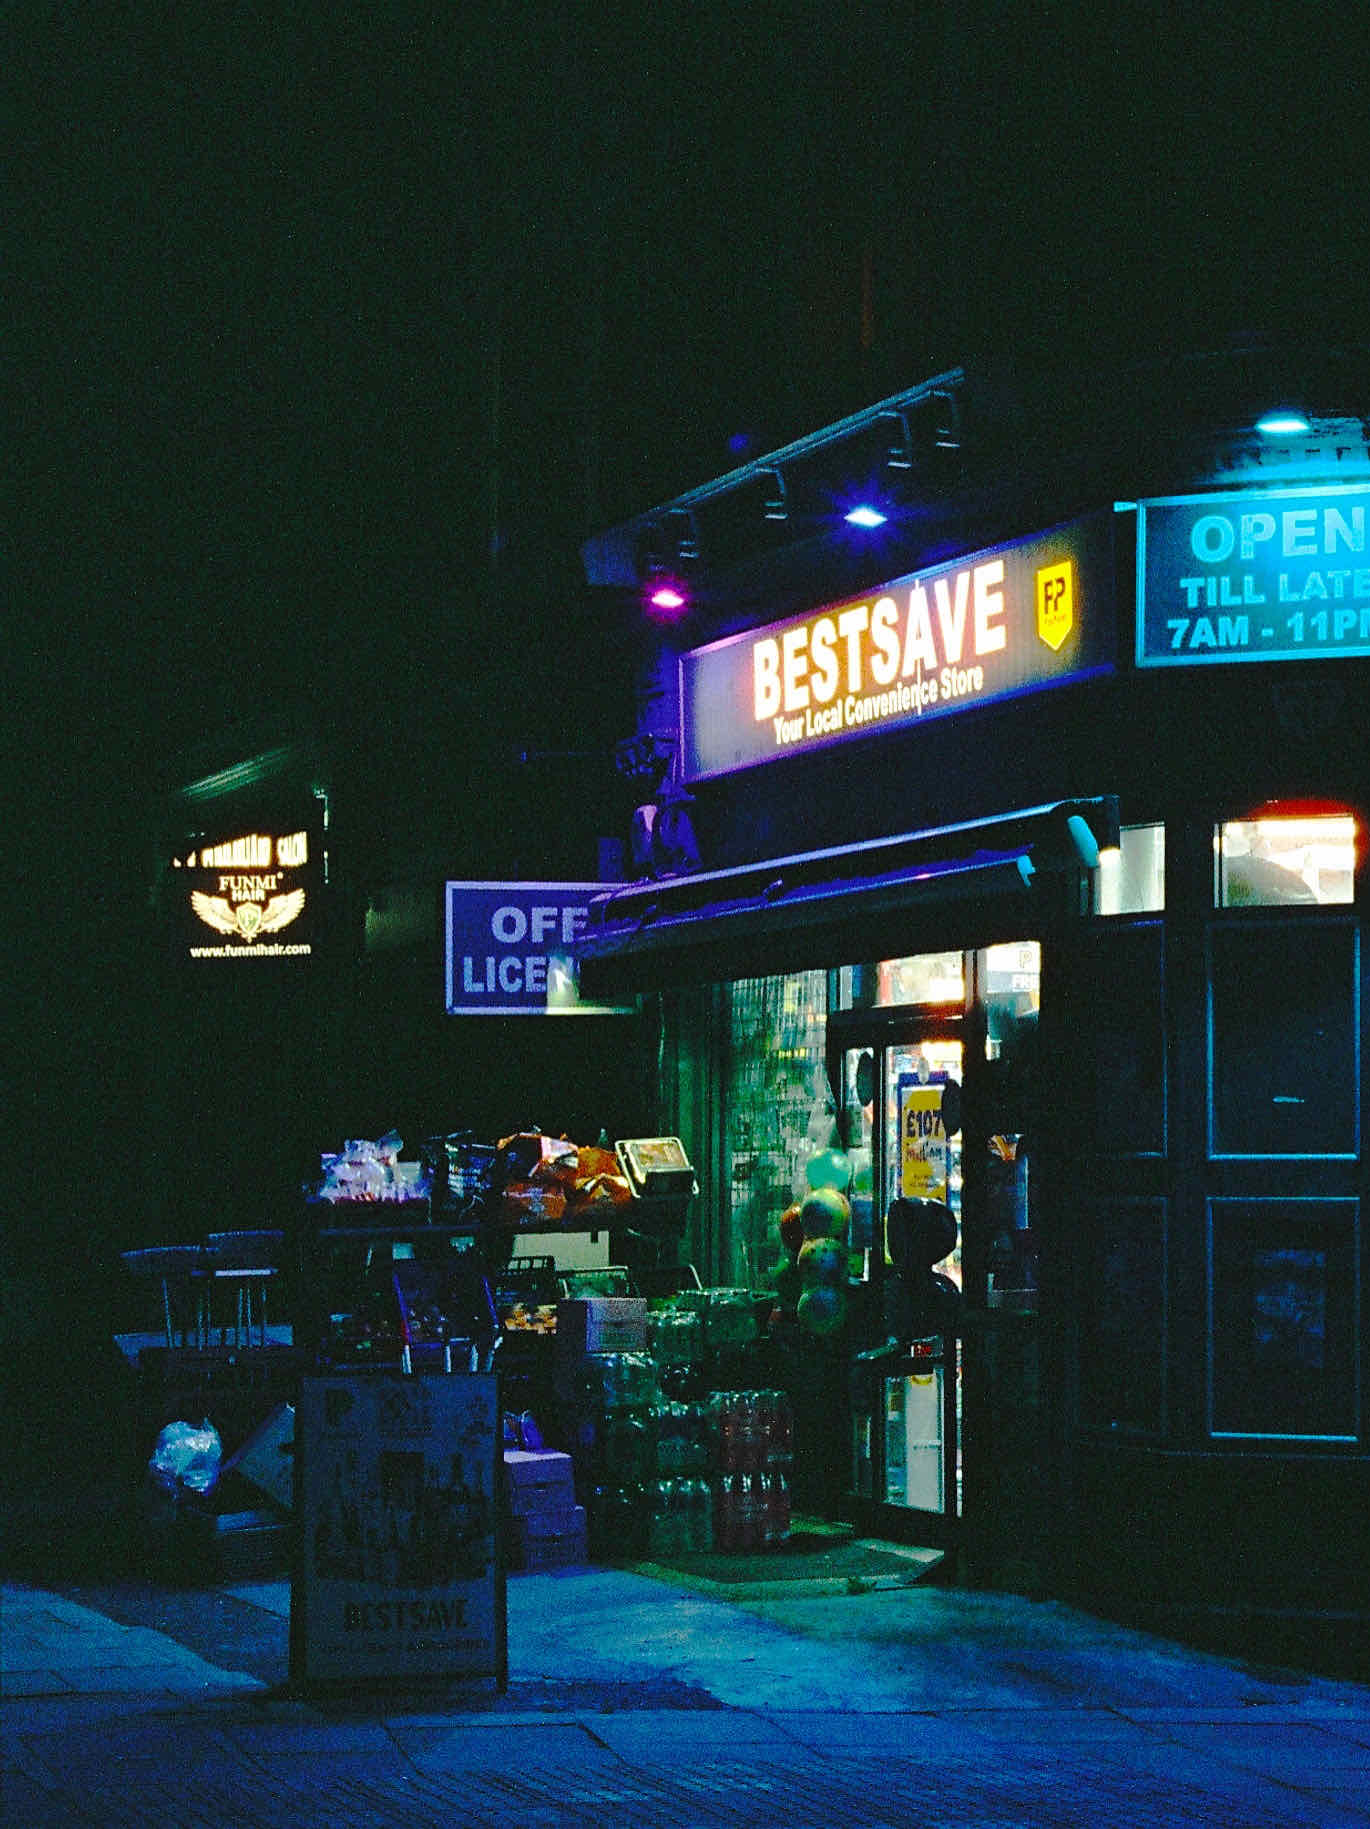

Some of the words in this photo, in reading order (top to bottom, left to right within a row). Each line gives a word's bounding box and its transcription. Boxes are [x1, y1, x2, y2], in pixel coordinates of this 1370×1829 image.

[1191, 506, 1365, 562] OPEN
[1180, 575, 1264, 608] TILL
[753, 559, 1007, 721] BESTSAVE
[1168, 615, 1249, 648] 7AM
[773, 714, 805, 745] Your
[806, 700, 843, 736] Local
[844, 678, 938, 727] Convenience
[940, 665, 984, 700] Store
[219, 875, 277, 891] FUNMI
[231, 888, 265, 902] HAIR
[491, 906, 588, 943] OFF
[190, 943, 312, 958] www.funmihair.com
